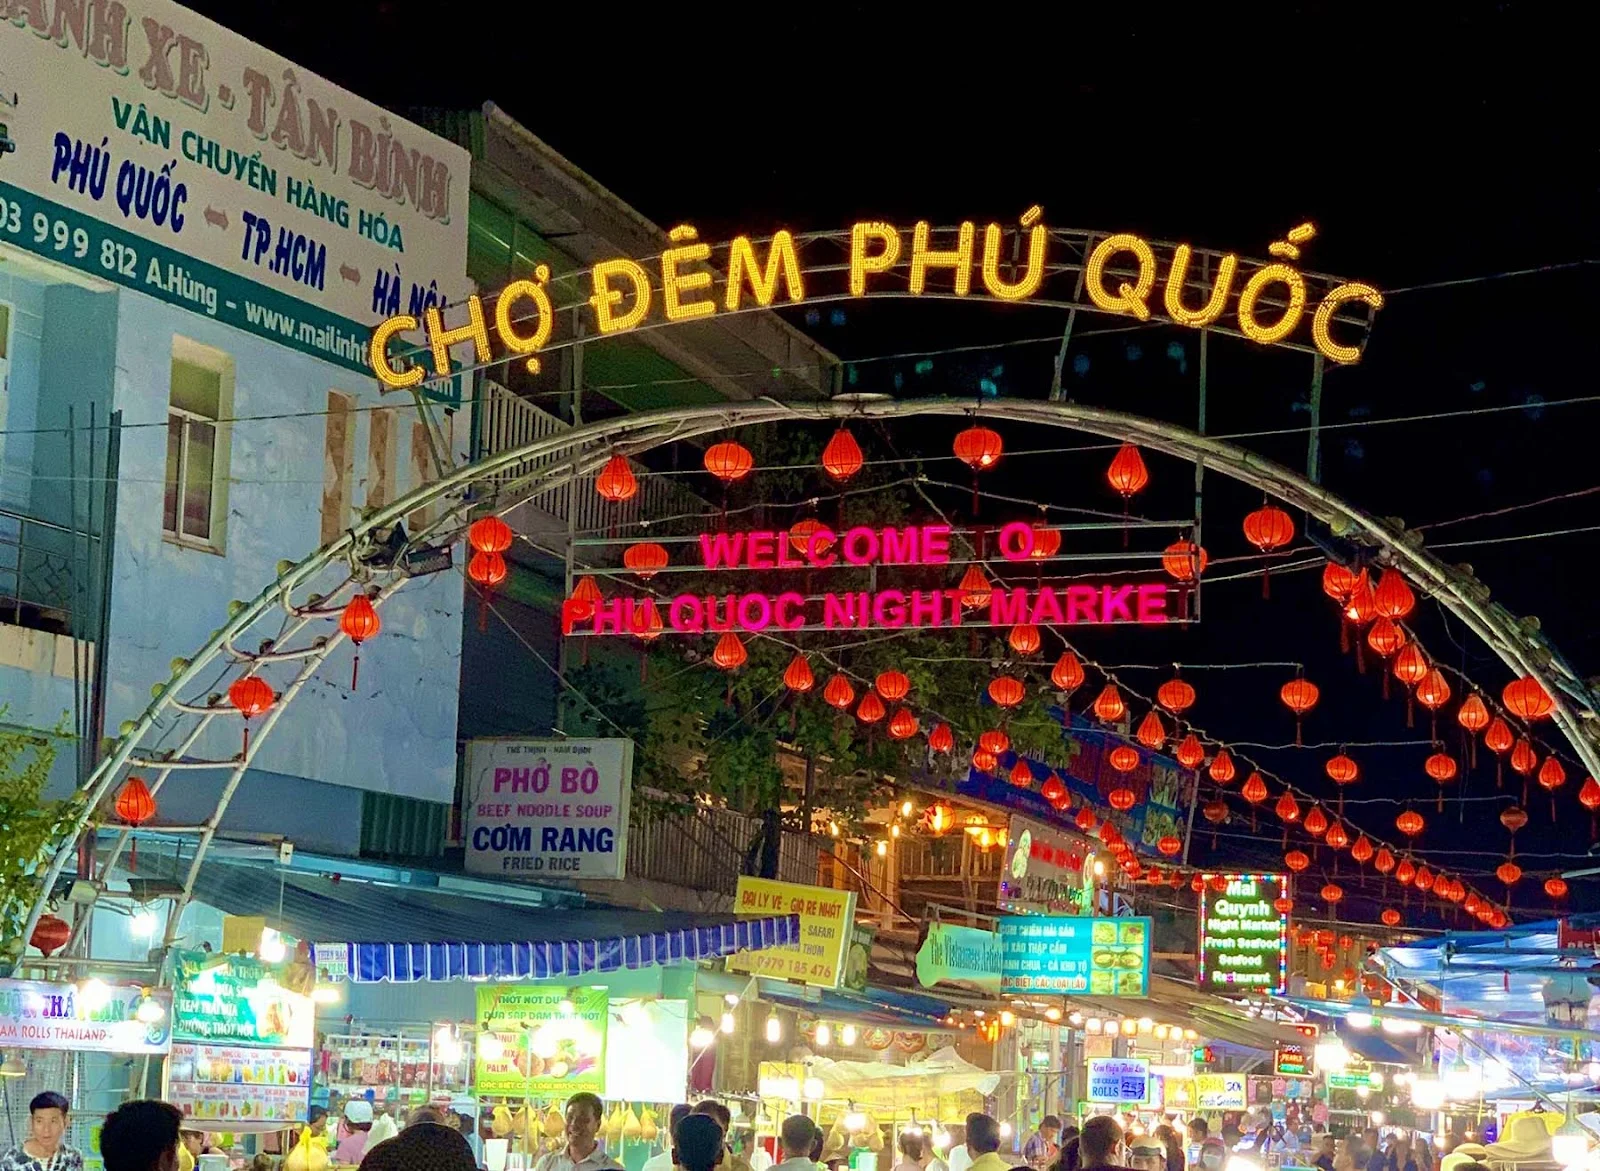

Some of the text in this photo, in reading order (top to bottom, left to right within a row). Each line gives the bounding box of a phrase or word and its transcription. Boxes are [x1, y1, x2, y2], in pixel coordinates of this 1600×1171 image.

[139, 16, 209, 113] XE
[244, 67, 340, 174] TÂN
[349, 116, 451, 225] BÌNH
[112, 96, 404, 252] VẬN CHUYỂN HÀNG HÓA
[51, 132, 110, 201] PHÚ
[116, 159, 187, 233] QUỐC
[242, 210, 326, 292] TP.HCM
[372, 262, 401, 317] HÀ
[100, 238, 137, 278] 812
[145, 256, 217, 316] A.Hùng
[369, 205, 1385, 390] CHỢ ĐÊM PHÚ QUỐC
[700, 524, 951, 571] WELCOME
[561, 597, 653, 637] PHU
[669, 593, 806, 633] QUOC
[823, 588, 968, 630] NIGHT
[561, 760, 599, 794] BÒ
[477, 804, 612, 818] BEEF NOODLE SOUP
[473, 823, 613, 853] CƠM RANG
[503, 856, 580, 871] FRIED RICE
[807, 924, 835, 939] SAFARI
[1207, 918, 1280, 933] Night Market
[1204, 937, 1281, 950] Fresh Seafood
[1218, 954, 1263, 966] Seafood
[790, 960, 808, 973] 185
[810, 964, 832, 978] 476
[21, 1025, 51, 1039] ROLLS
[55, 1027, 107, 1041] THAILAND
[486, 1063, 508, 1073] PALM
[1101, 1077, 1119, 1085] CREAM
[1092, 1086, 1119, 1097] ROLLS
